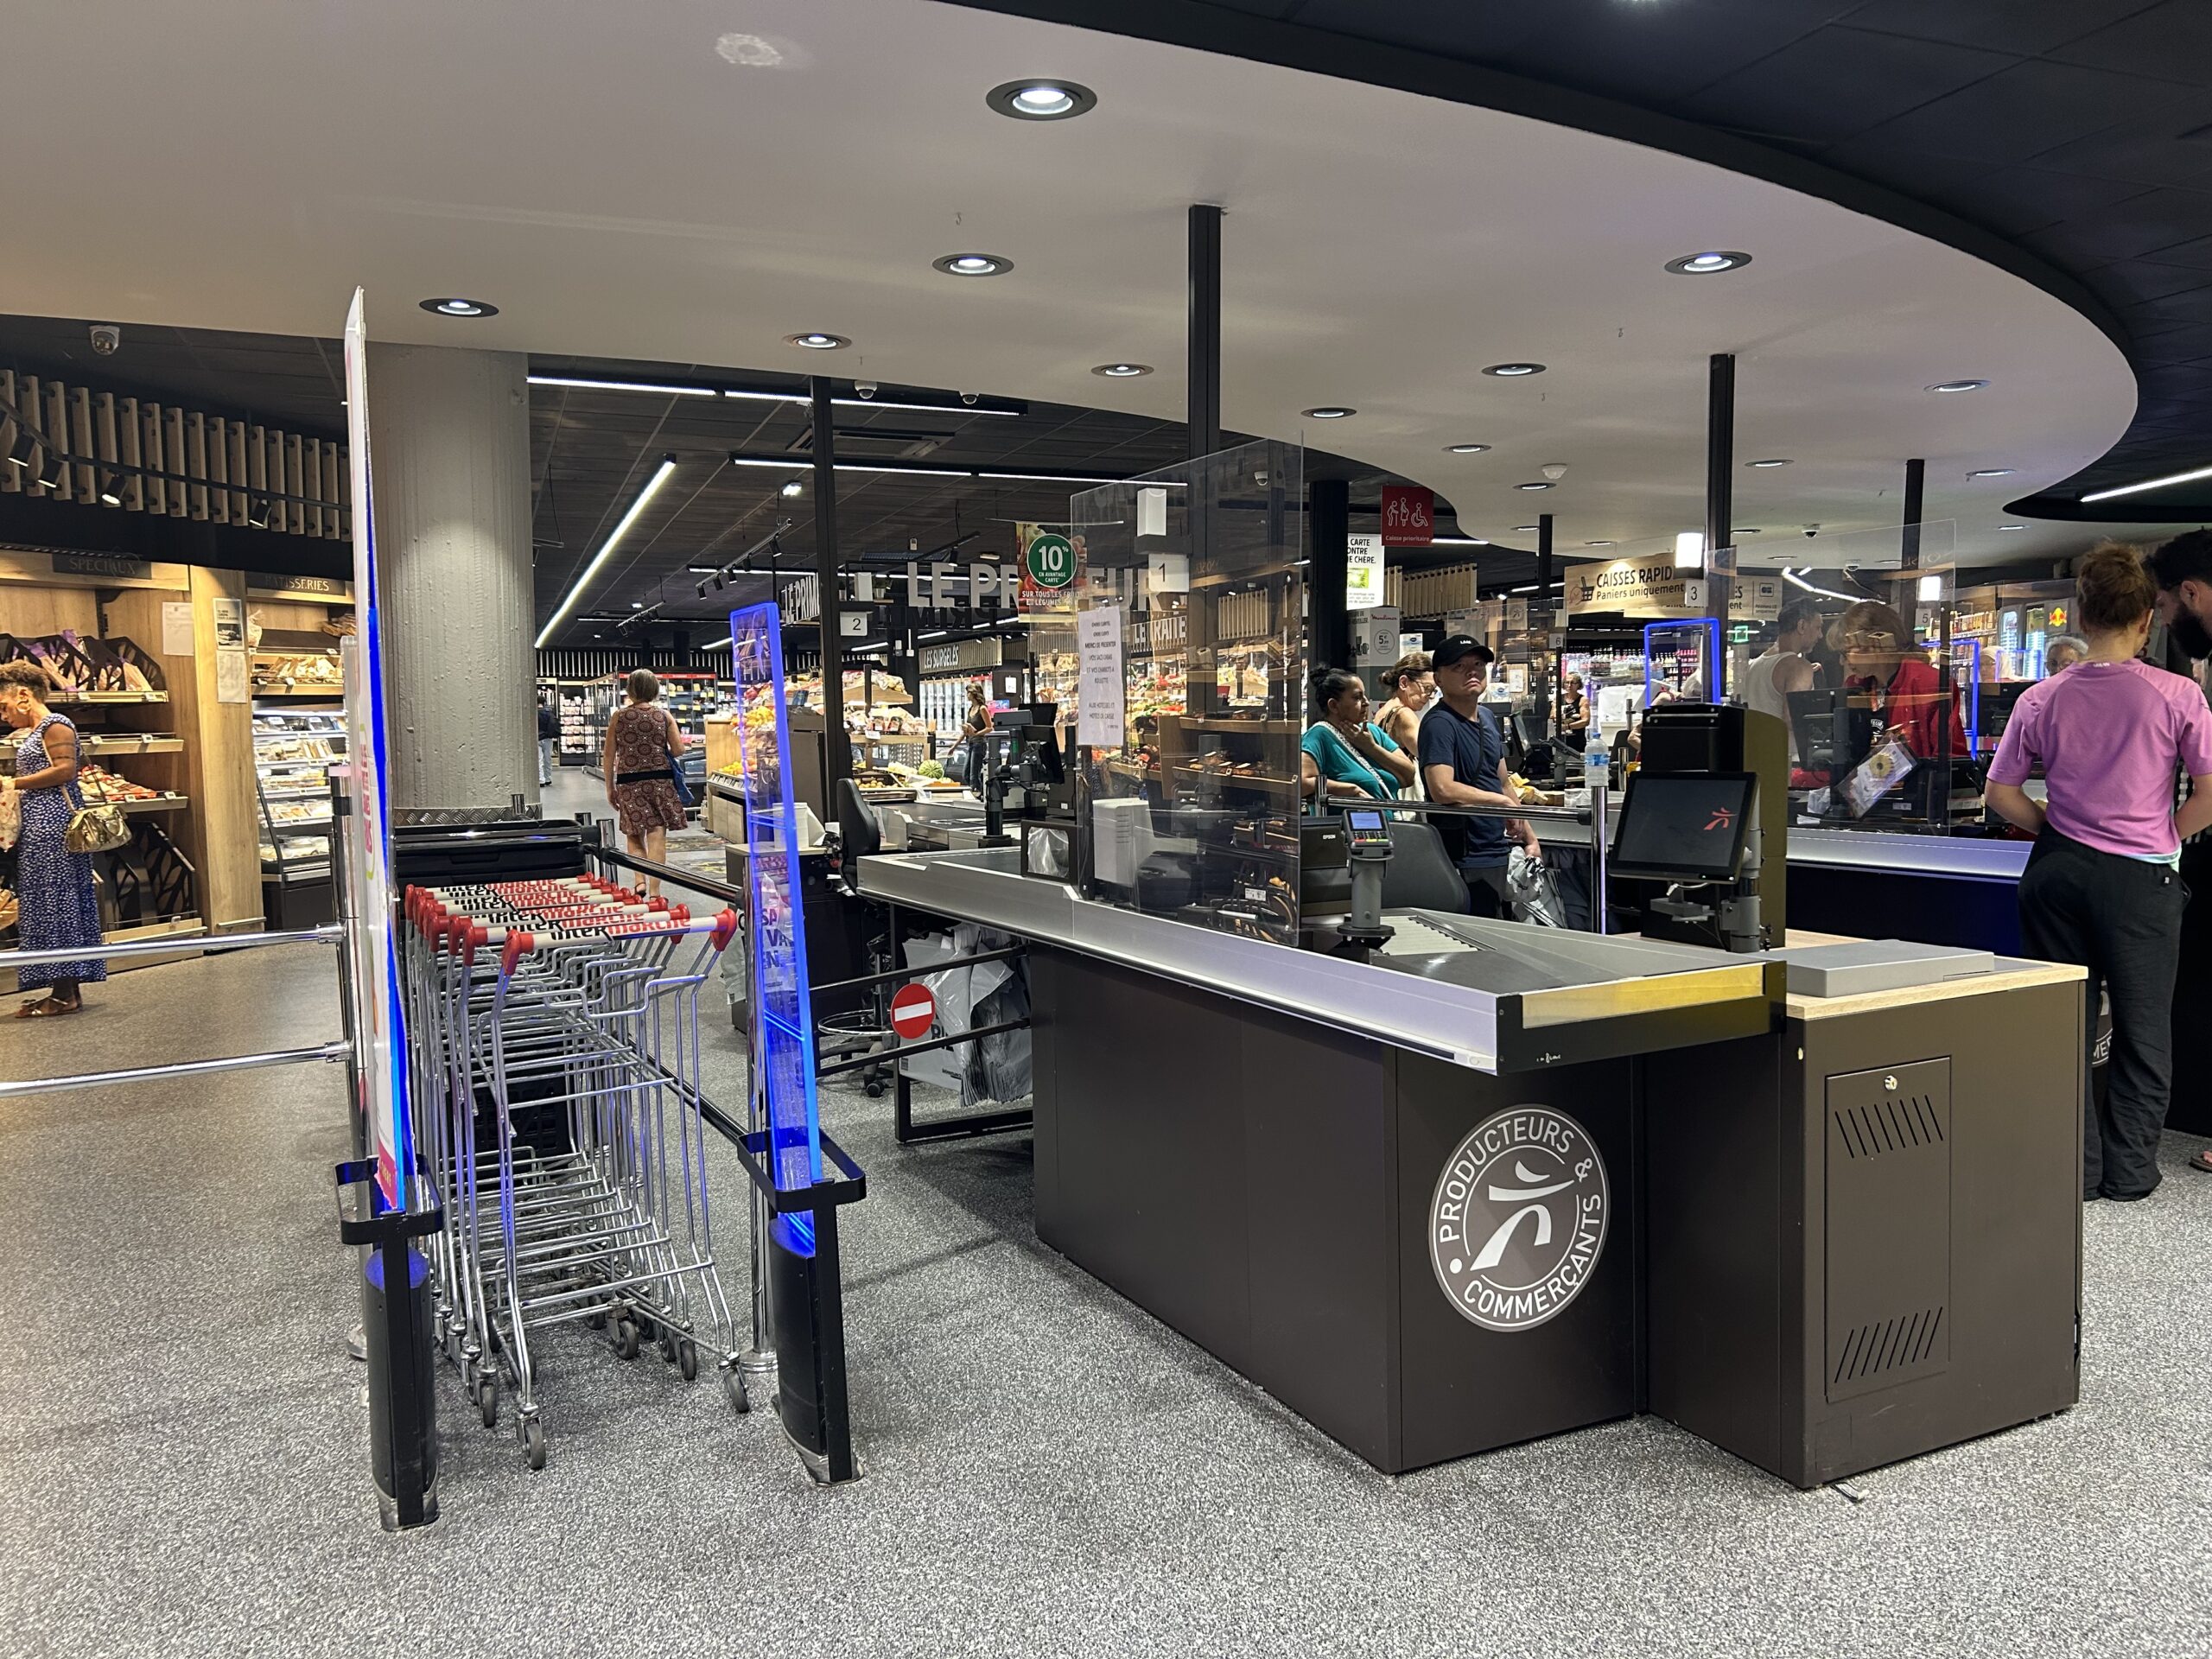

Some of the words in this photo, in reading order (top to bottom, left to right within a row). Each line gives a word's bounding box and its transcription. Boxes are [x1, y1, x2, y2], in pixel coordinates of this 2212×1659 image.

[1350, 538, 1370, 547] CARTE
[1039, 545, 1069, 571] 10%
[1158, 563, 1166, 582] 1
[1597, 569, 1636, 588] CAISSES
[1639, 565, 1673, 583] RAPID
[265, 575, 329, 592] PTISSERIES
[907, 562, 955, 607] LE
[1596, 588, 1627, 601] Paniers
[1630, 582, 1685, 599] uniquement
[1690, 586, 1698, 601] 3
[785, 583, 795, 624] LE
[852, 618, 862, 631] 2
[1922, 613, 1929, 624] 5
[1555, 637, 1561, 645] 6
[1440, 1116, 1574, 1243] PRODUCTEURS
[1574, 1157, 1593, 1183] &
[1464, 1194, 1601, 1319] COMMERÇANTS
